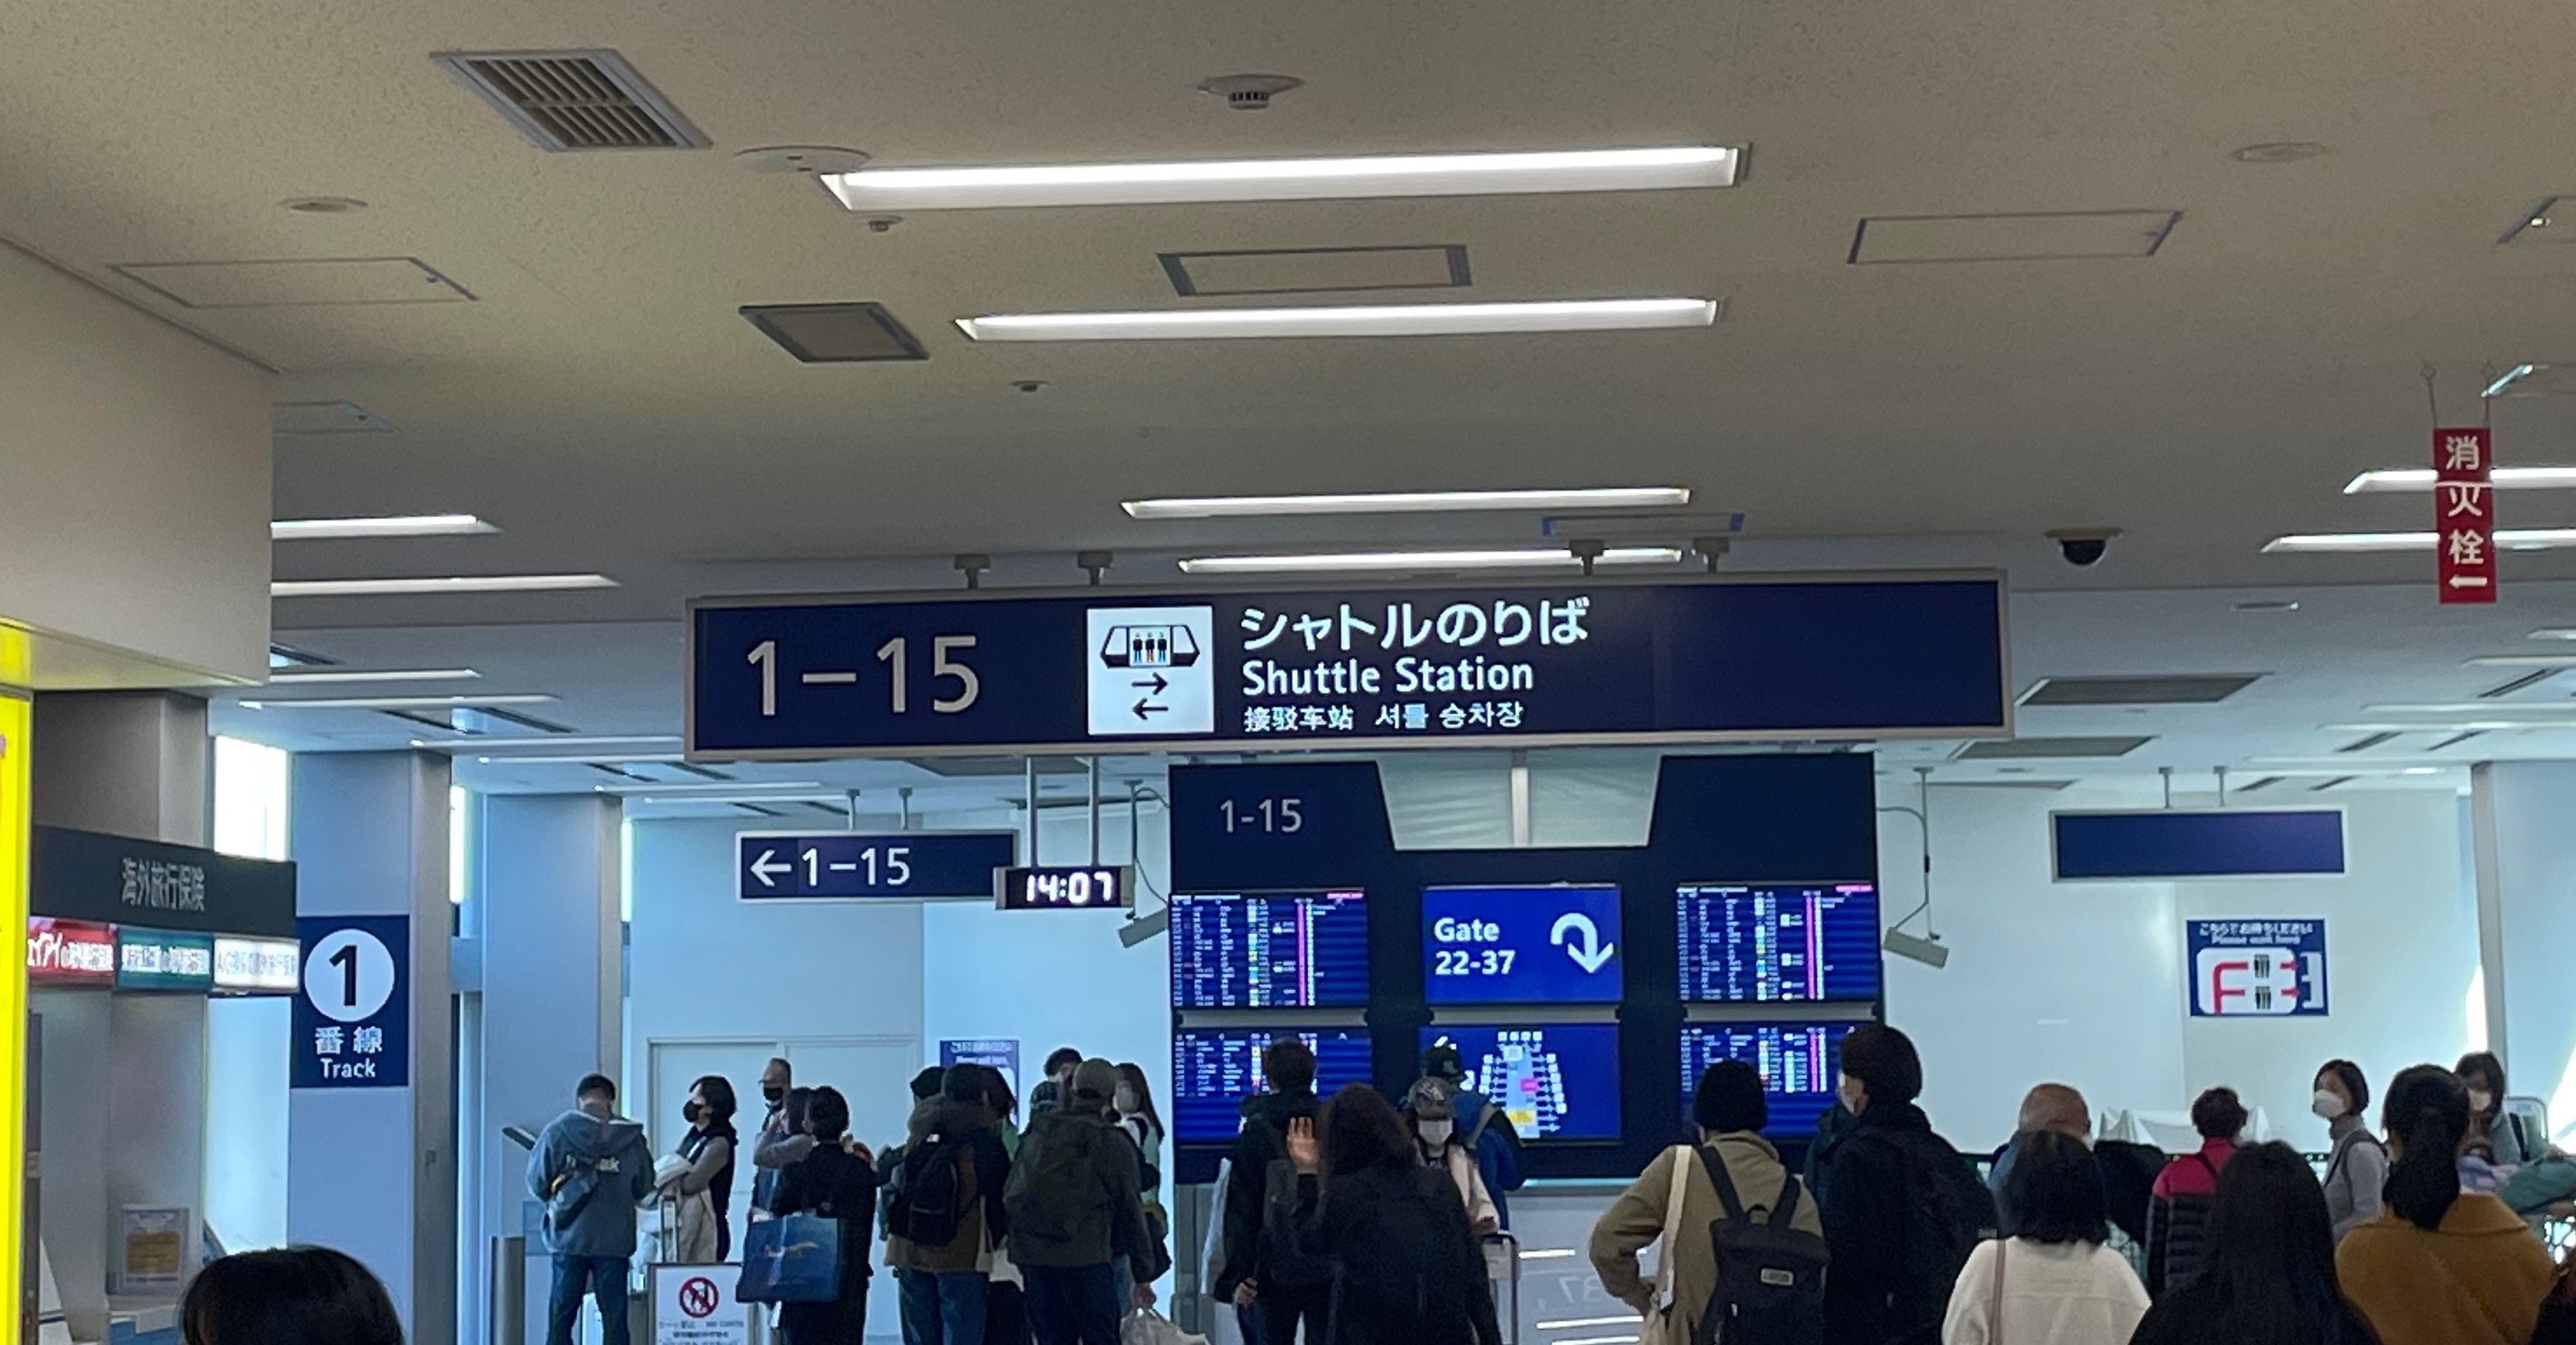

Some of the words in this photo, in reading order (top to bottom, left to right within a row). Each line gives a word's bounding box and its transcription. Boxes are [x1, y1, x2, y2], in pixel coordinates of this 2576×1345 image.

[2446, 435, 2484, 565] 消火栓
[1241, 597, 1590, 651] シャトルのりば
[748, 635, 979, 716] 1-15
[1243, 659, 1380, 694] Shuttle
[1395, 656, 1533, 693] Station
[1439, 700, 1523, 728] 승차장
[1220, 799, 1302, 833] 1-15
[801, 847, 910, 887] 1-15
[1025, 871, 1112, 903] 14:07
[1434, 917, 1500, 943] Gate
[329, 945, 357, 1007] 1
[1434, 950, 1516, 975] 22-37
[315, 1026, 383, 1055] 番線
[320, 1057, 376, 1079] Track
